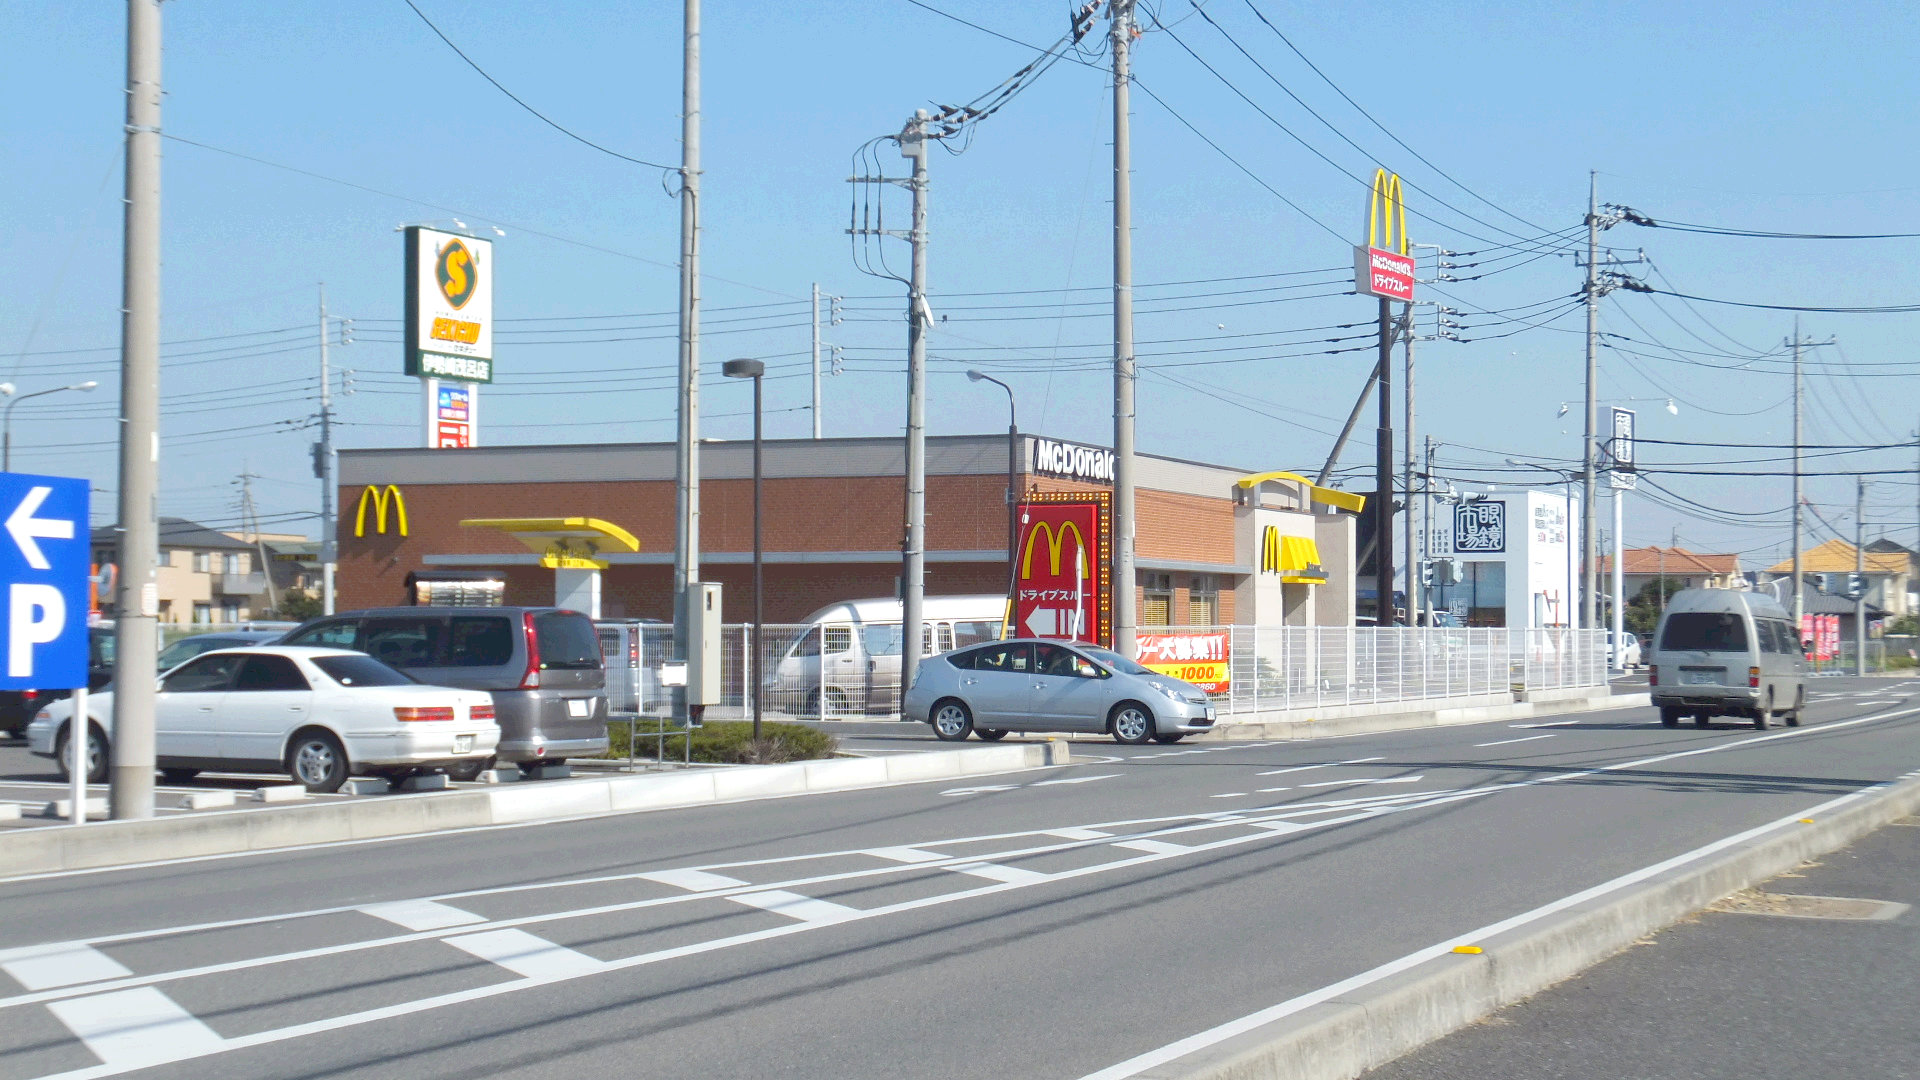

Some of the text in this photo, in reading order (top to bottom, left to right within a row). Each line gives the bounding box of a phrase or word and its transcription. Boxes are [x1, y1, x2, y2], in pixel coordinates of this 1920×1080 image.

[1372, 254, 1411, 277] McDonald's
[1374, 273, 1409, 293] ドライブスルー
[8, 583, 66, 678] P
[1060, 608, 1085, 636] IN
[1180, 666, 1215, 680] 1000
